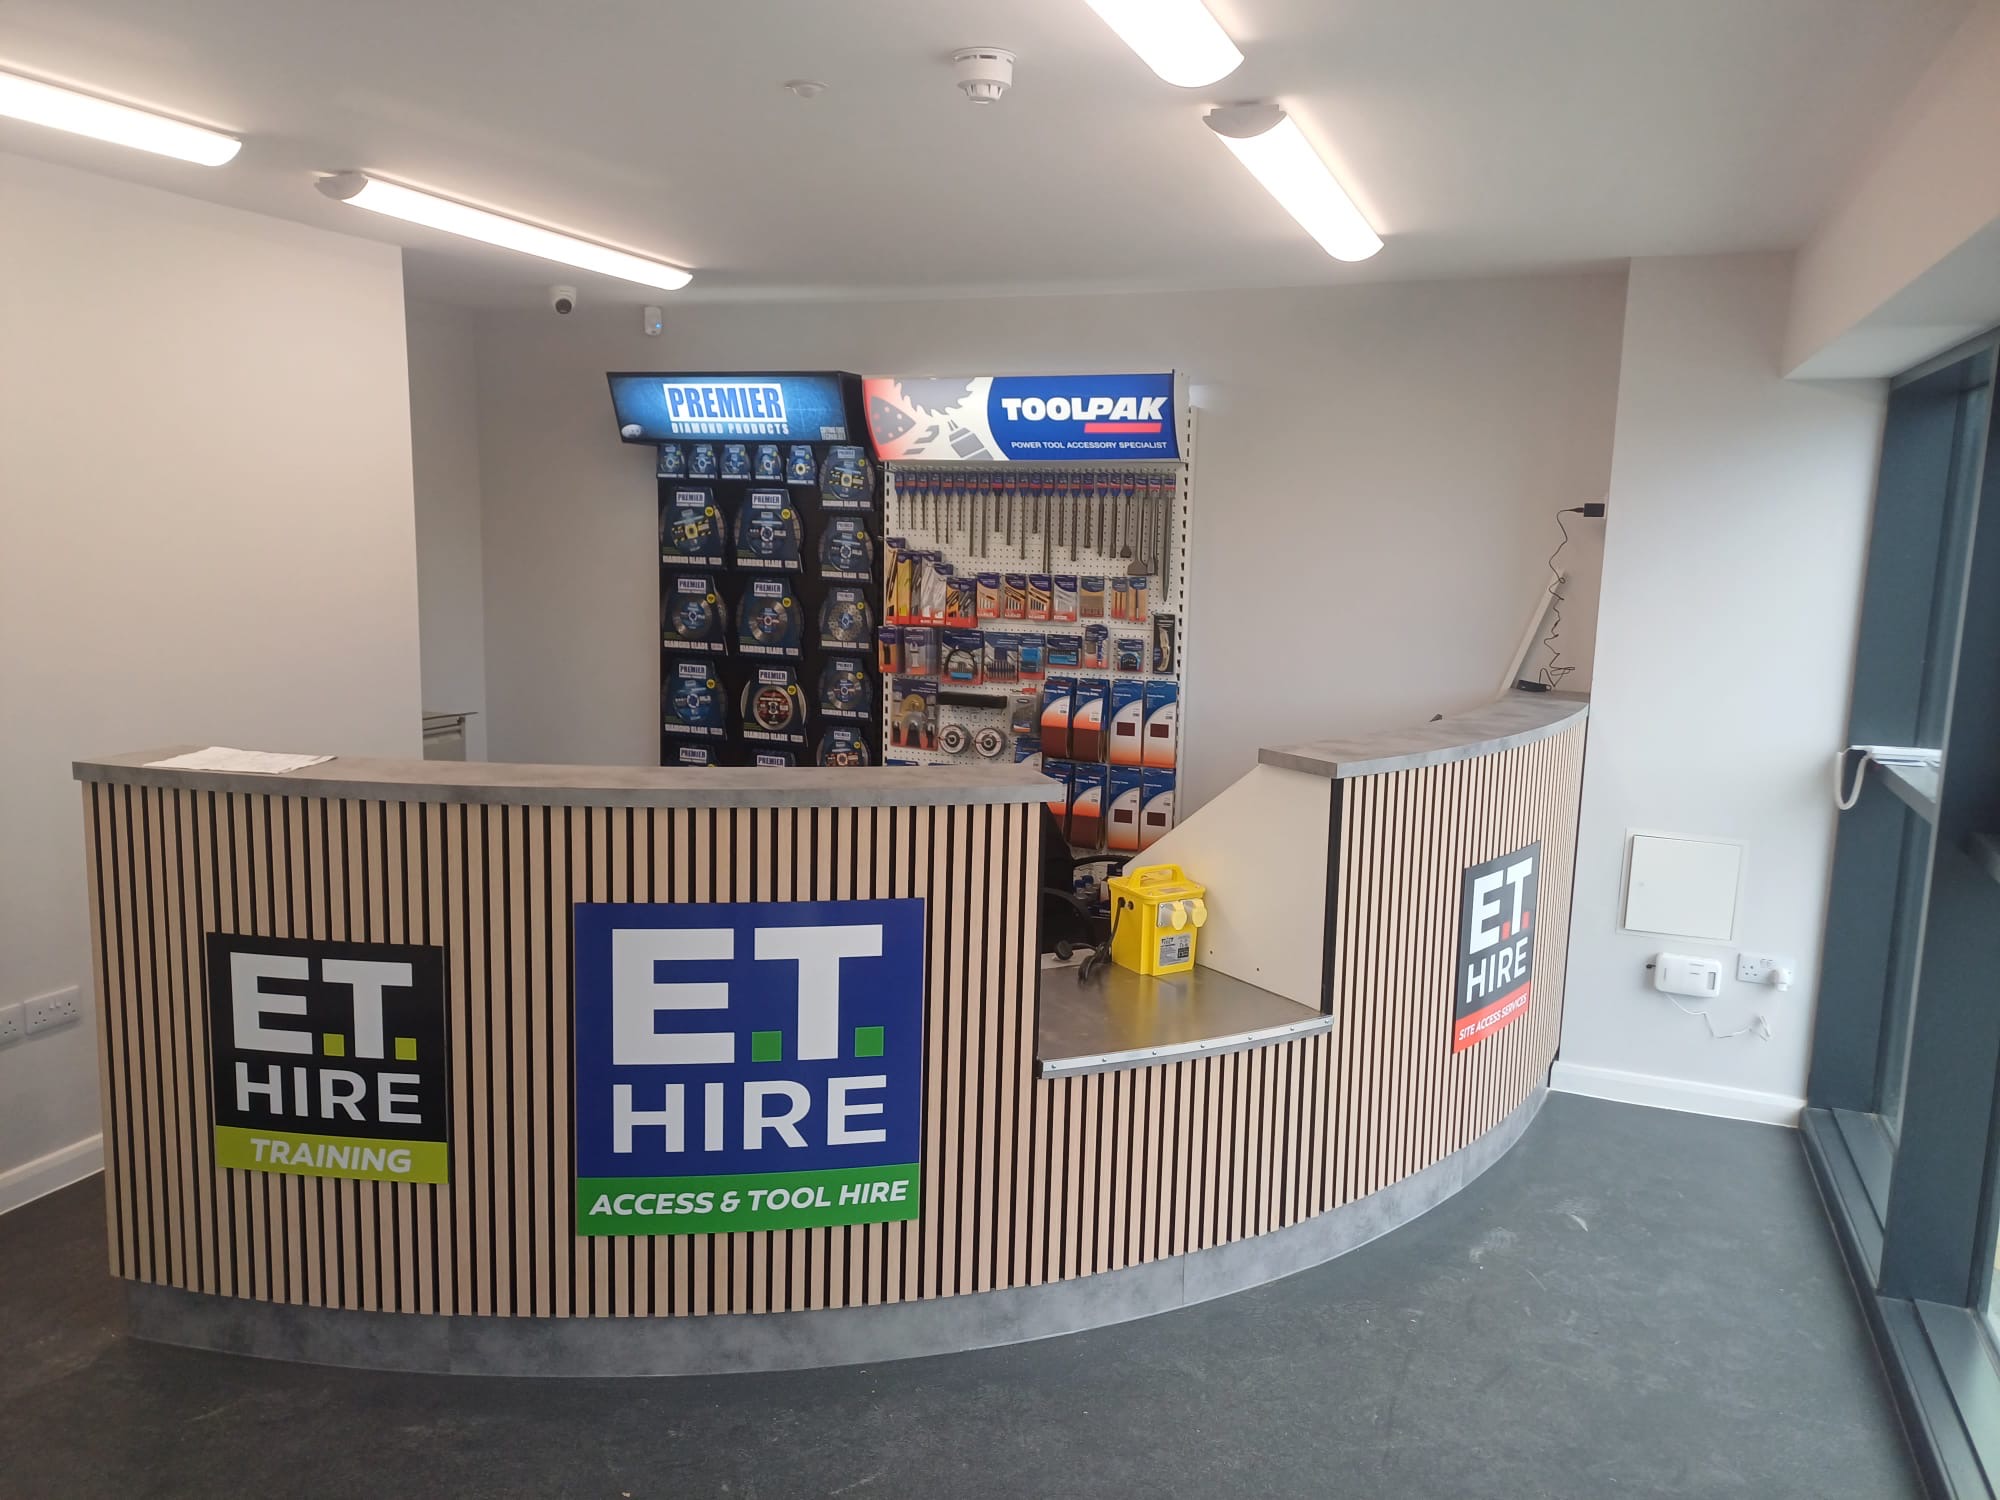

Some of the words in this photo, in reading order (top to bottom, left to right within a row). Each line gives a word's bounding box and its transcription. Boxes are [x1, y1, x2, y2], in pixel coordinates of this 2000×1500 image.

[668, 387, 783, 418] PREMIER
[1001, 397, 1168, 421] TOOLPAK
[671, 422, 724, 434] DIAMOND
[728, 423, 789, 435] PRODUCTS
[1011, 441, 1041, 449] POWER
[1043, 441, 1064, 449] TOOL
[1066, 441, 1117, 449] ACCESSORY
[1119, 441, 1167, 449] SPECIALIST
[1469, 857, 1533, 955] E.T.
[1466, 936, 1528, 1004] HIRE
[230, 952, 418, 1061] E.T.
[611, 924, 885, 1066] E.T.
[1459, 1023, 1476, 1041] SITE
[1475, 1009, 1501, 1033] ACCESS
[1501, 992, 1528, 1019] SERVICES
[235, 1061, 422, 1124] HIRE
[613, 1074, 887, 1153] HIRE
[250, 1138, 412, 1174] TRAINING
[589, 1192, 715, 1216] ACCESS
[720, 1190, 741, 1213] &
[747, 1186, 831, 1211] TOOL
[838, 1179, 909, 1206] HIRE
